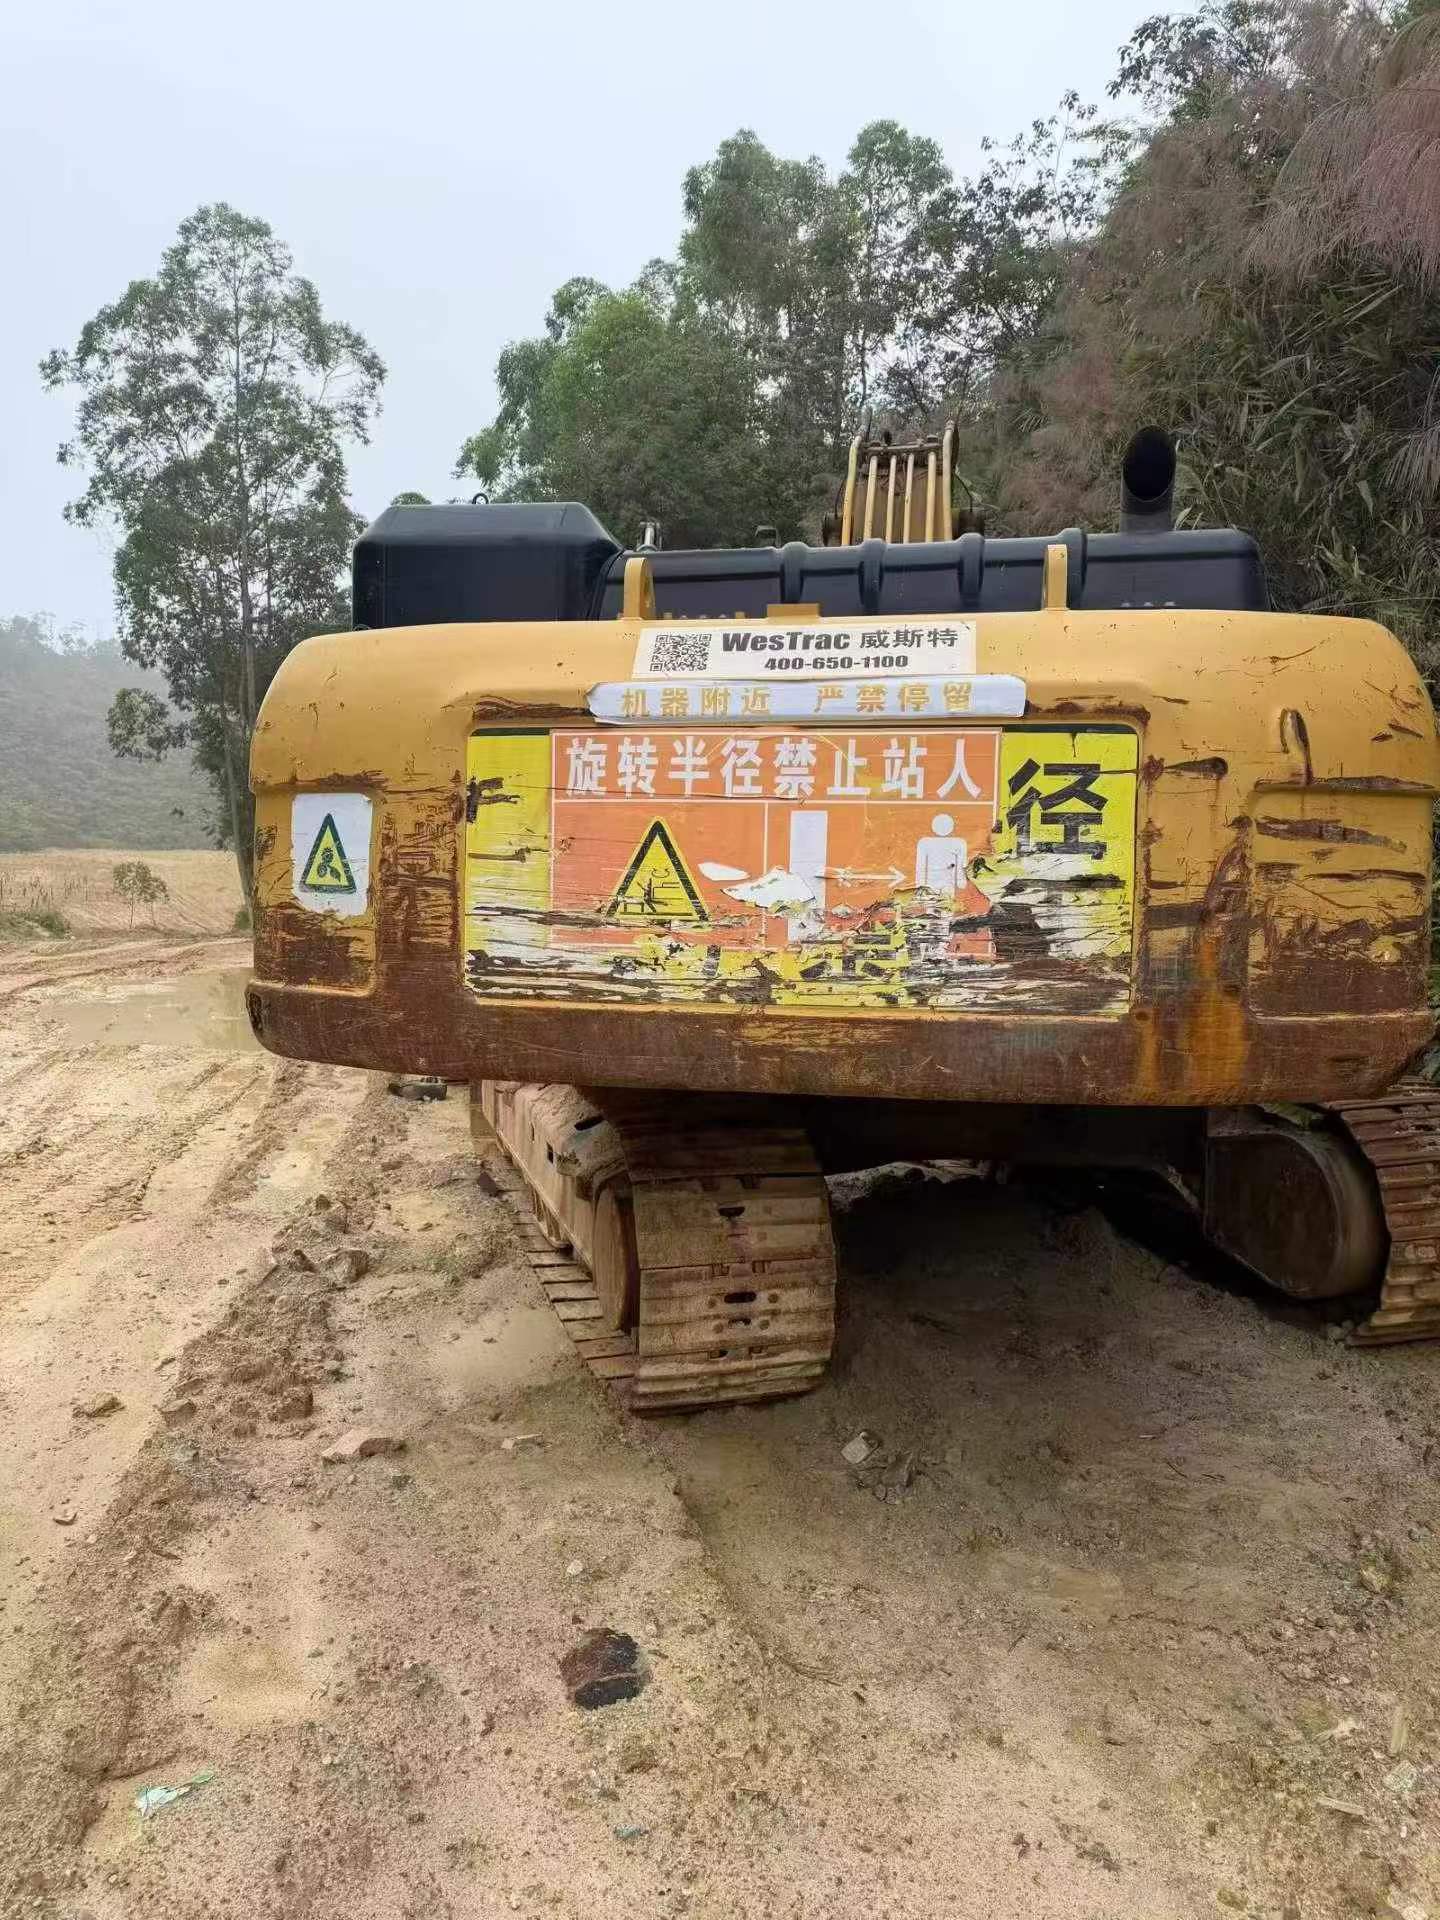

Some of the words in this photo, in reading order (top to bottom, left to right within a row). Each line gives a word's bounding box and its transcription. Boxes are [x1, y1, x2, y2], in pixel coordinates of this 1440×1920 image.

[722, 631, 850, 652] WesTrac
[859, 629, 959, 649] 威斯特
[764, 654, 908, 671] 400-650-1100
[621, 686, 772, 718] 机器附近
[814, 682, 974, 713] 严禁停留
[567, 737, 982, 799] 旋转半径禁止站人
[1006, 758, 1109, 860] 径
